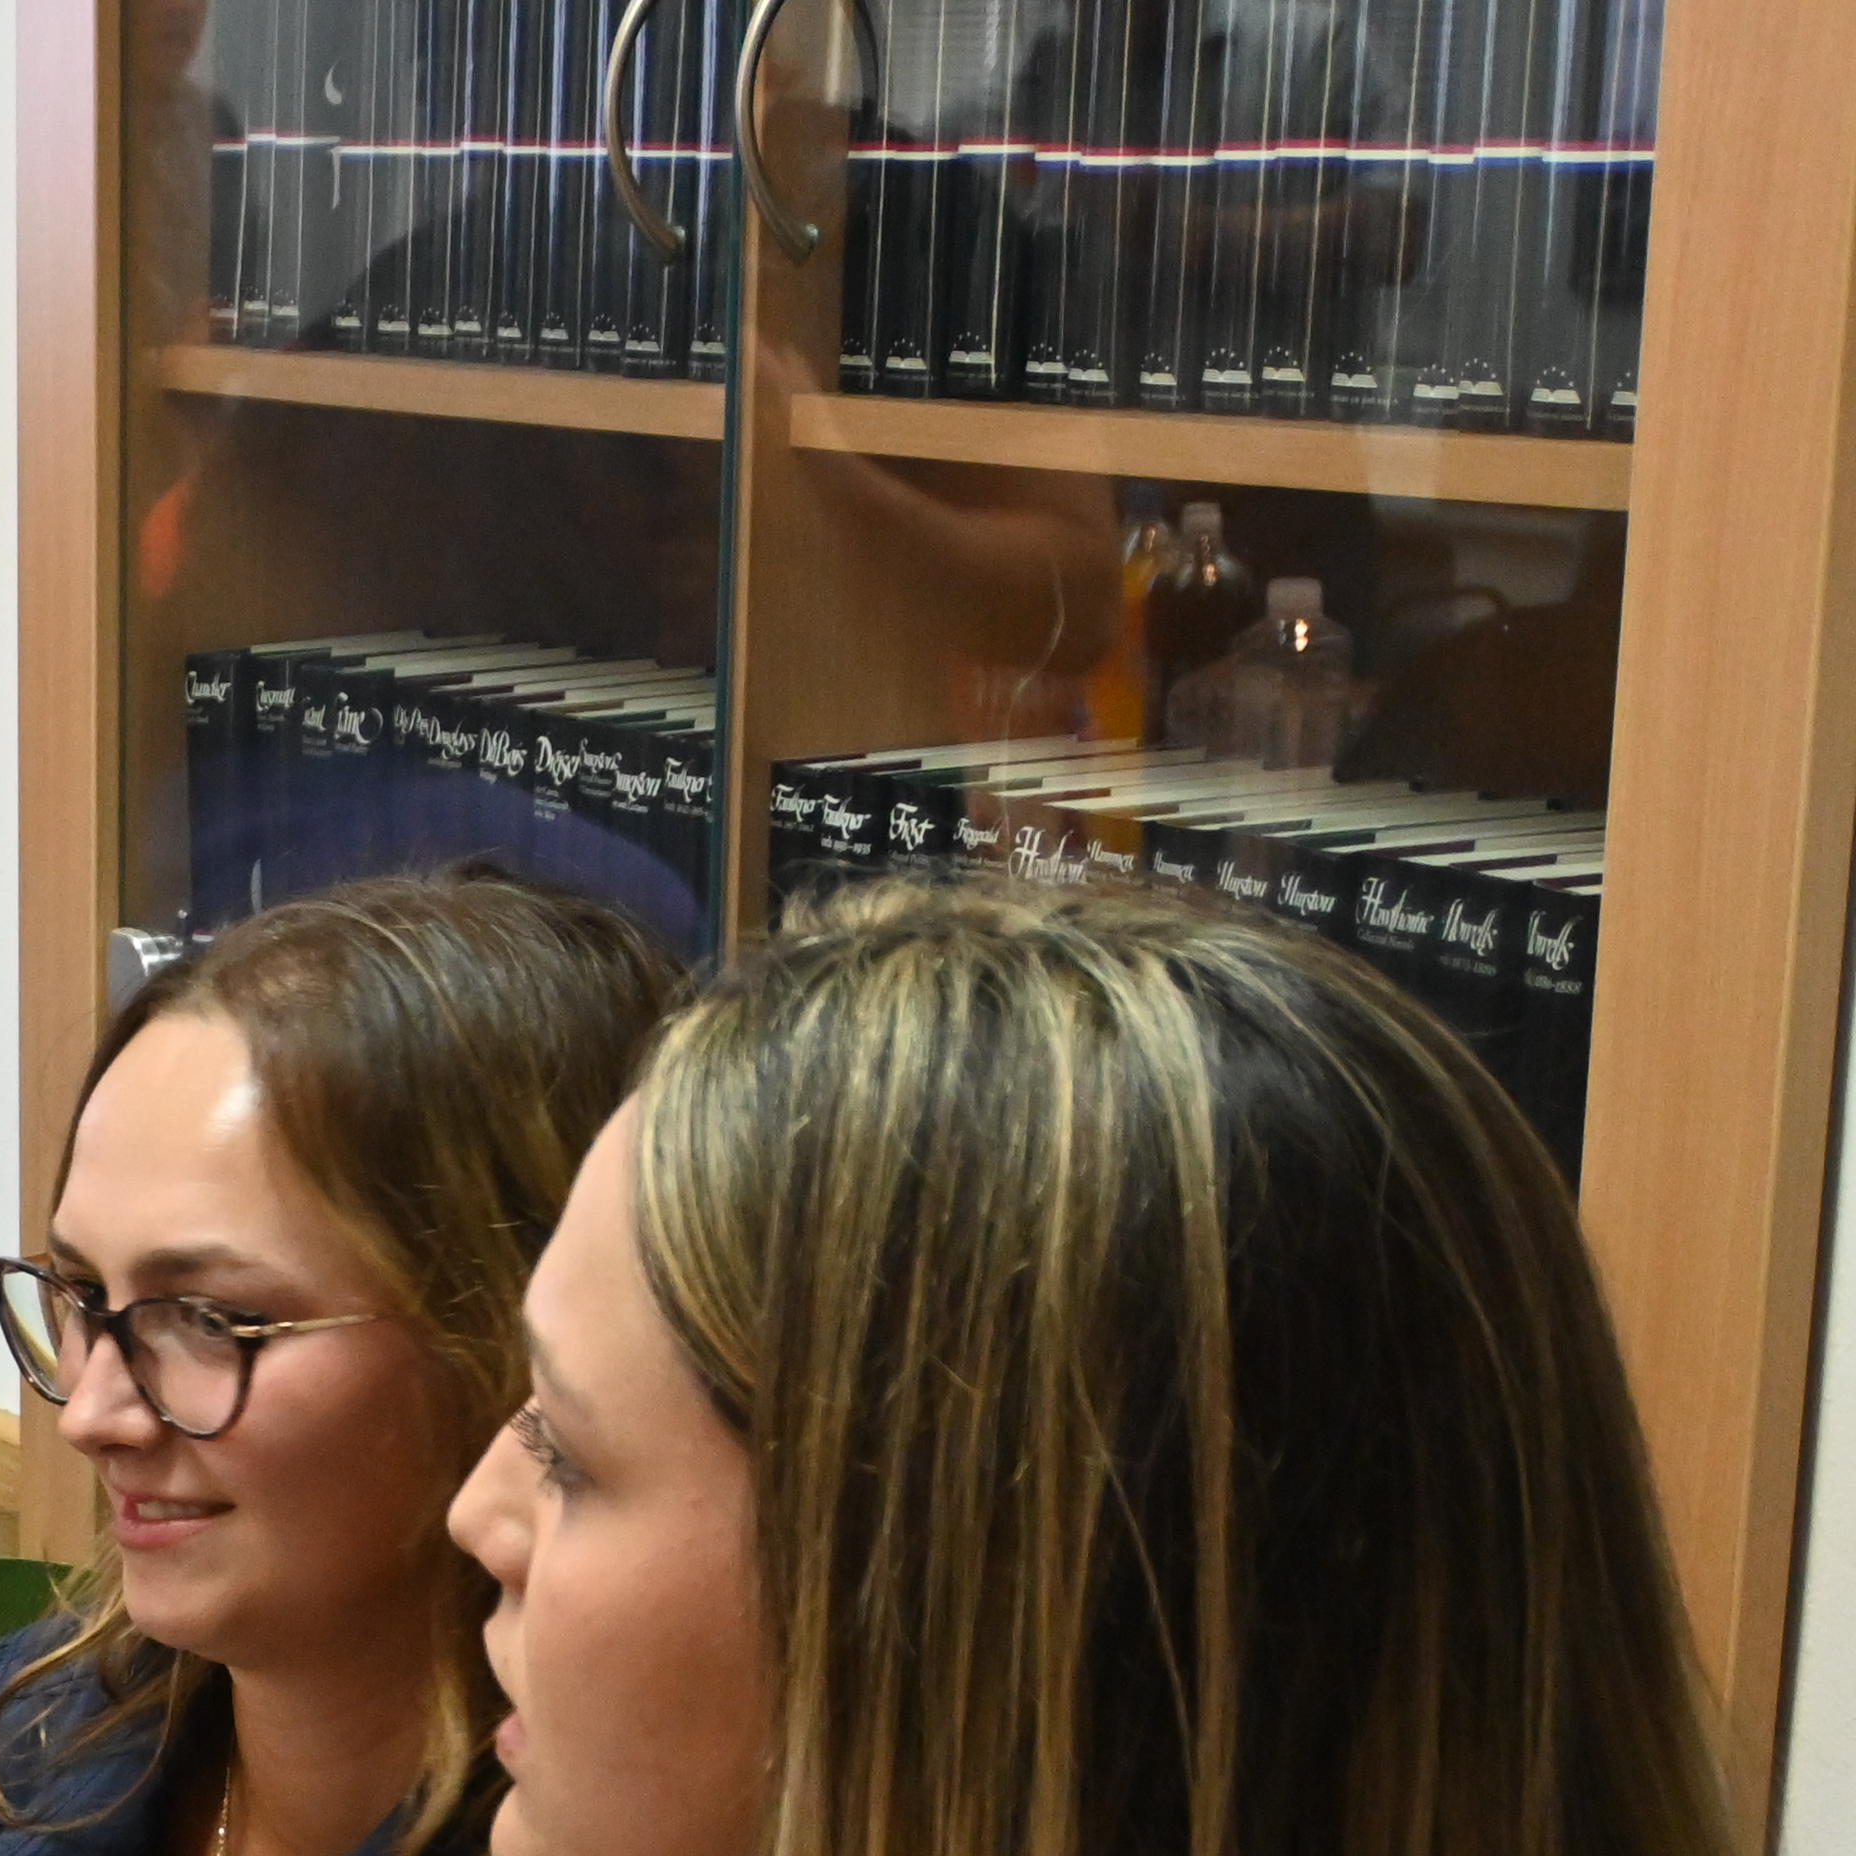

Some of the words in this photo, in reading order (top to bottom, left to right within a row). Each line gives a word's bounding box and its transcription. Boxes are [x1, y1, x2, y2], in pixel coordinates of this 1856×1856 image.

[889, 802, 936, 851] Frost
[1278, 871, 1336, 916] Hurston
[1356, 876, 1435, 935] Hawthorne
